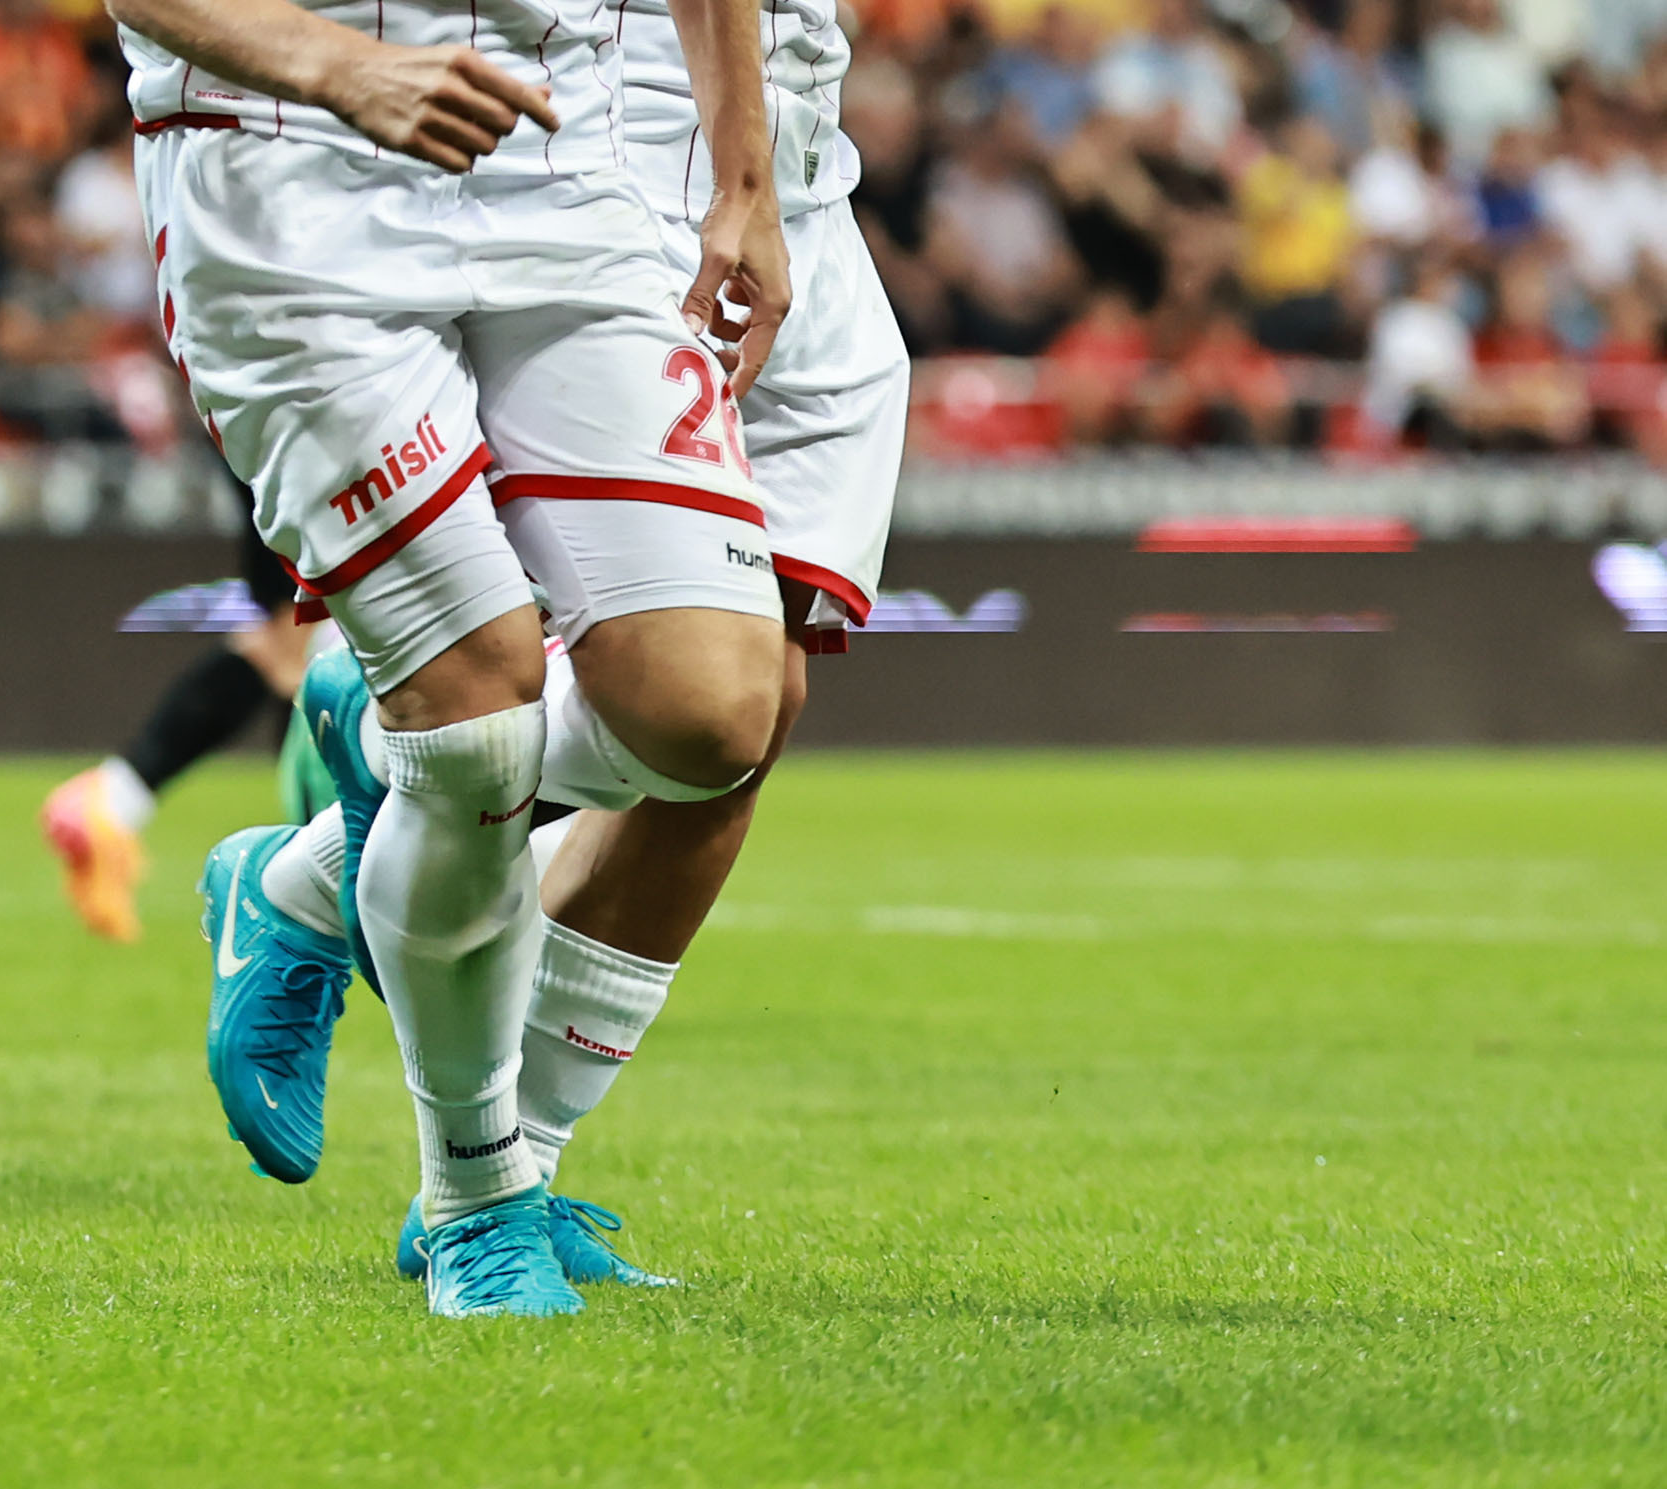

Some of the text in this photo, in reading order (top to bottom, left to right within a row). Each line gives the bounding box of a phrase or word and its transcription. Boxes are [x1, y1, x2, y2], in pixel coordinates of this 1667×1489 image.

[329, 412, 447, 526] misli
[566, 1025, 633, 1058] humm
[446, 1126, 520, 1160] humme
